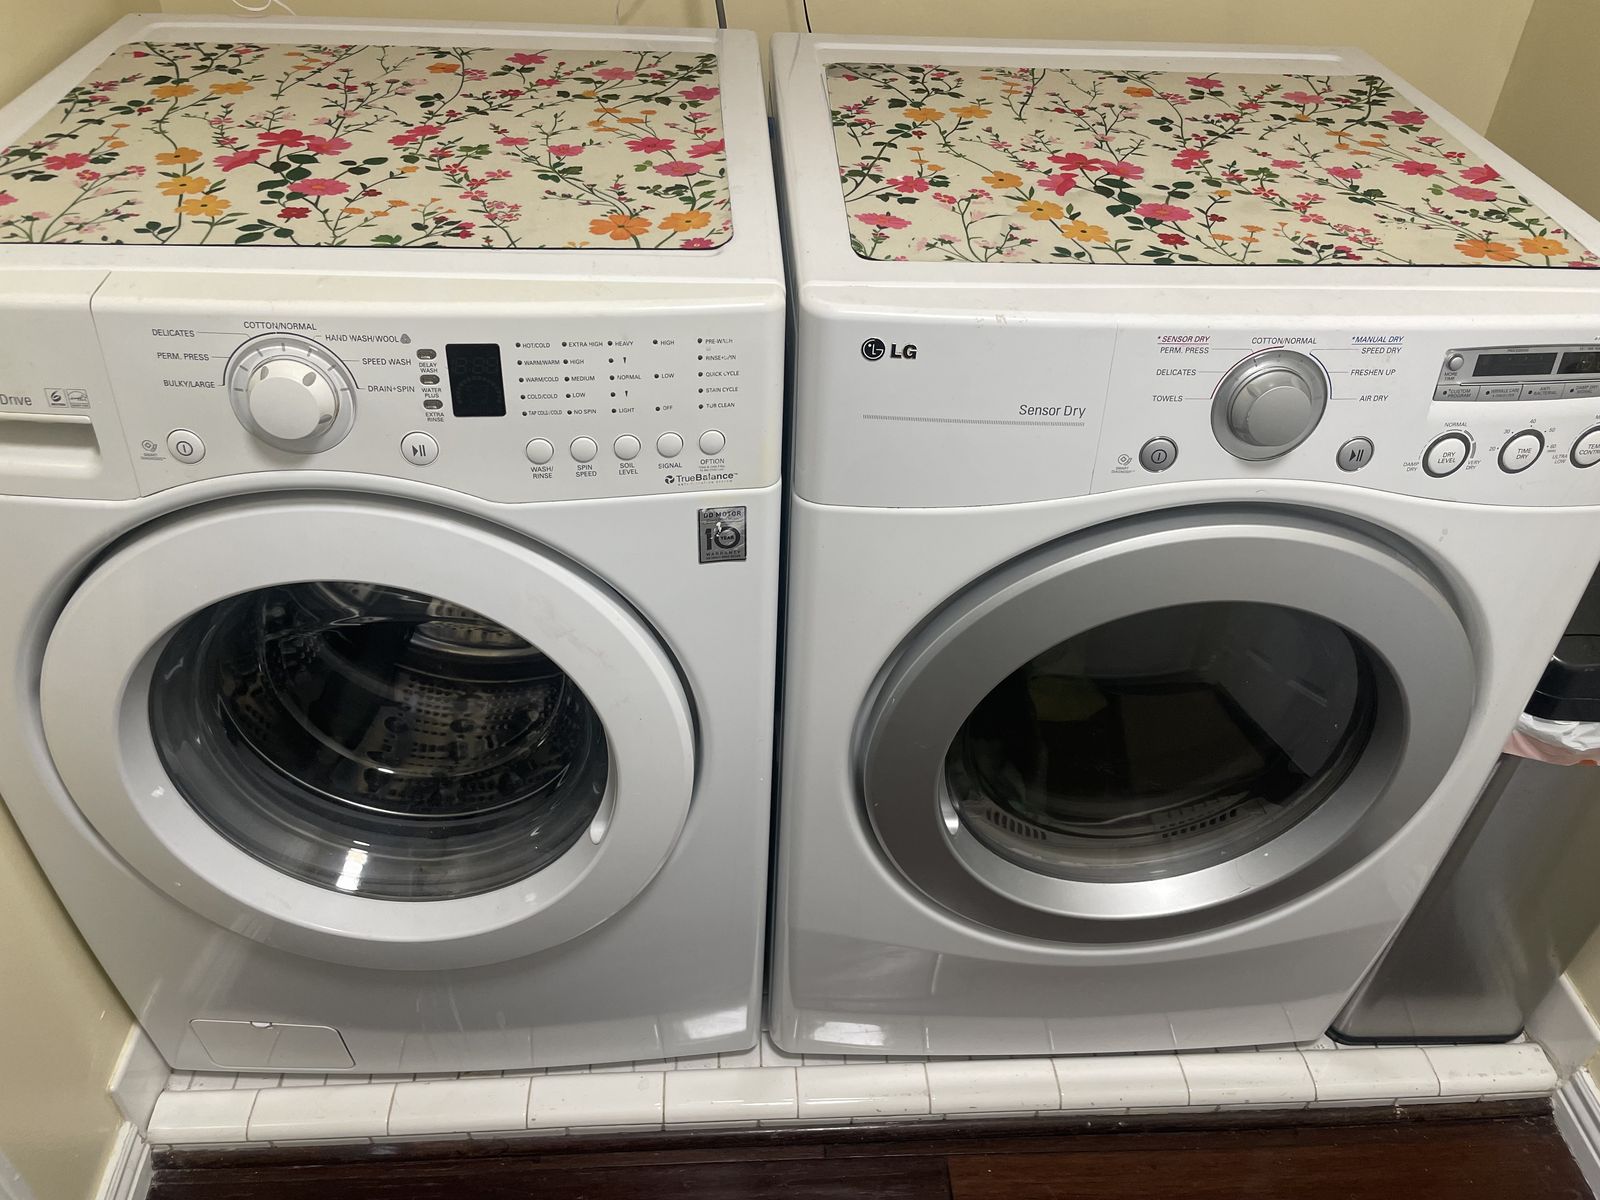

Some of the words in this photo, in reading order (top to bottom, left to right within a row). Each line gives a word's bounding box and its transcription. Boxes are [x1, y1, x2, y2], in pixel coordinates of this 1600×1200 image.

[243, 321, 317, 331] COTTON/NORMAL
[152, 329, 195, 337] DELICATES
[350, 335, 399, 343] WASH/WOOL
[1251, 337, 1317, 345] COTTON/NORMAL
[890, 343, 917, 360] LG
[183, 353, 209, 361] PRESS
[362, 357, 386, 366] SPEED
[388, 358, 411, 366] WASH
[163, 379, 215, 388] BULKY/LARGE
[367, 385, 415, 393] DRAIN+SPIN
[1019, 404, 1061, 416] Sensor
[1063, 405, 1086, 418] Dry
[705, 526, 741, 550] 10
